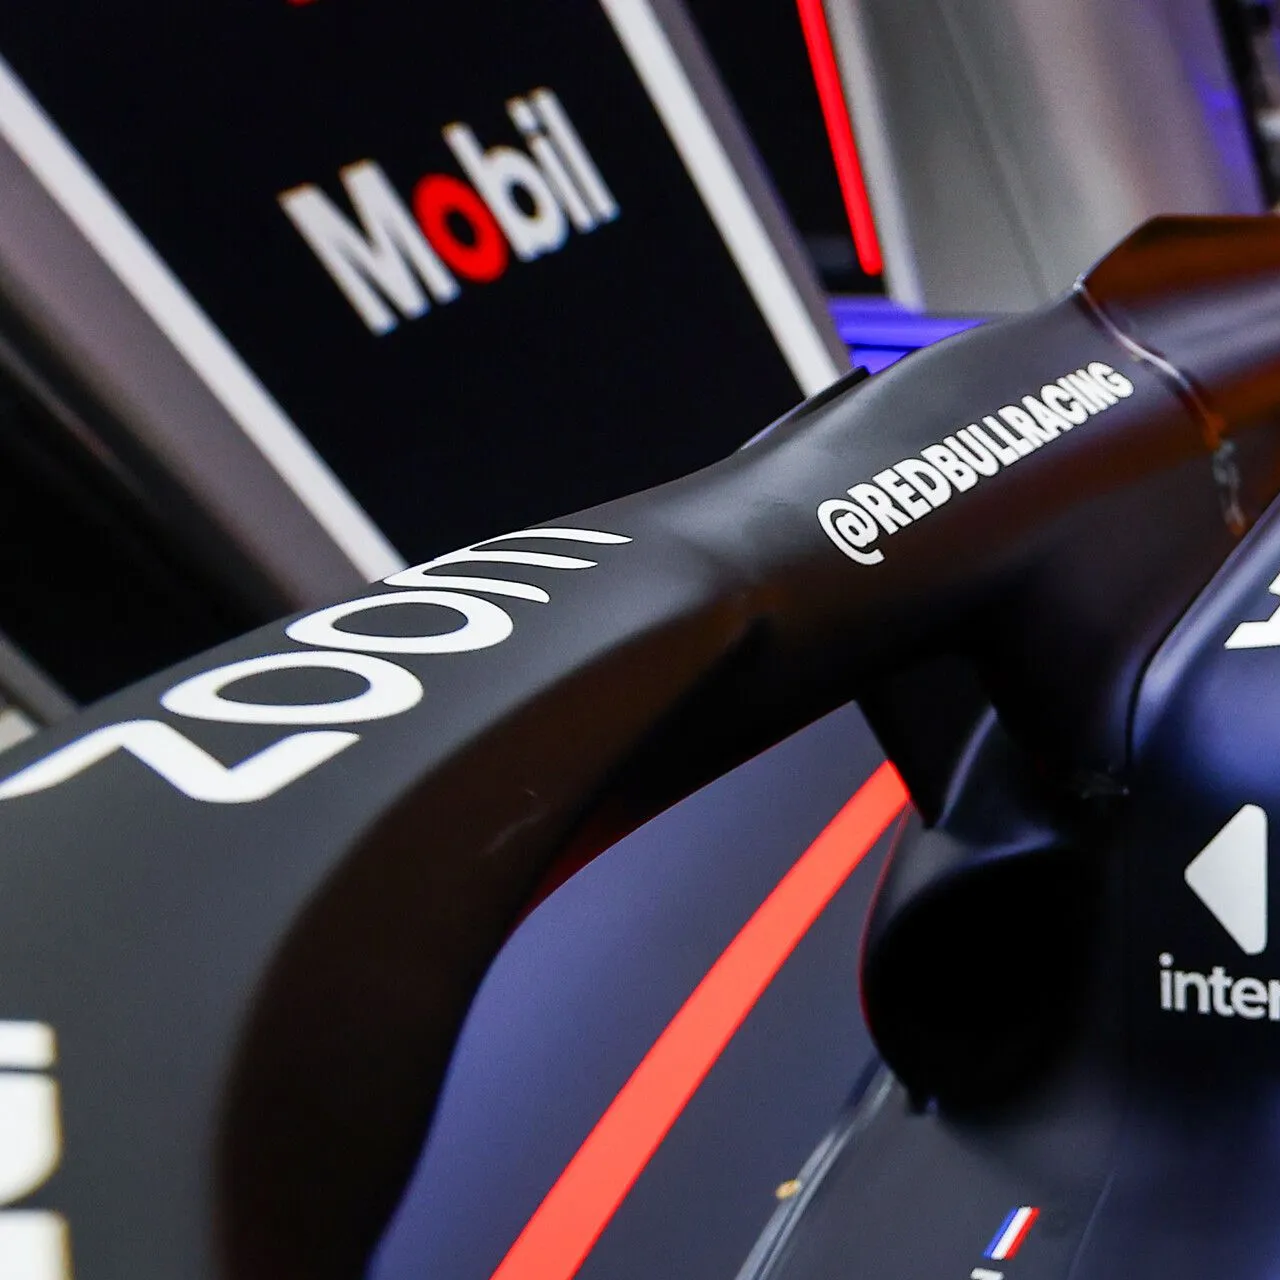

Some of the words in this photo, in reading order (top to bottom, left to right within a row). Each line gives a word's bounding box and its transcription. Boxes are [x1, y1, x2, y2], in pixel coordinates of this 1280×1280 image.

[280, 88, 619, 334] Mobil
[817, 361, 1135, 565] @REDBULLRACING
[0, 527, 632, 803] zoom
